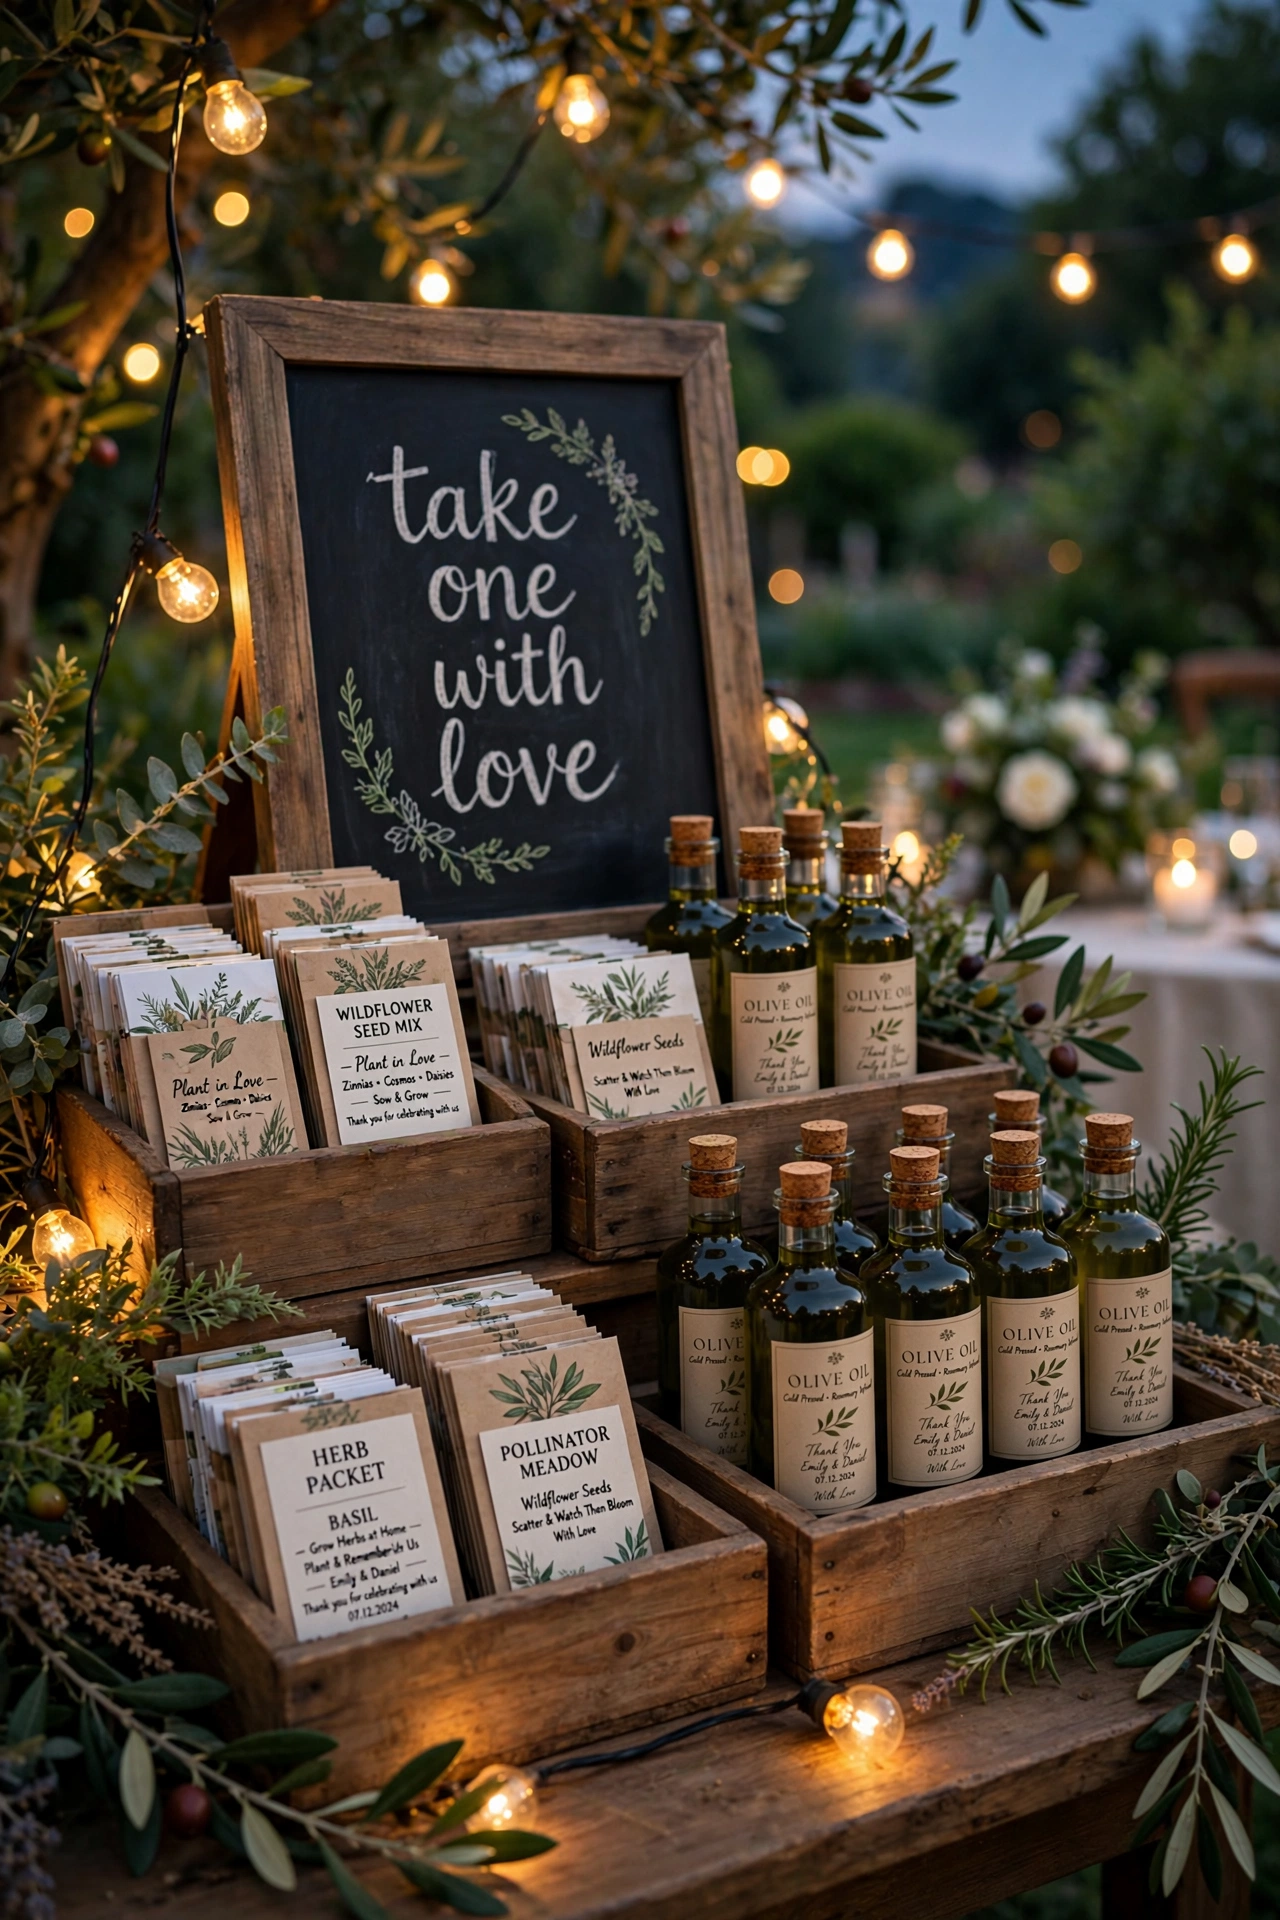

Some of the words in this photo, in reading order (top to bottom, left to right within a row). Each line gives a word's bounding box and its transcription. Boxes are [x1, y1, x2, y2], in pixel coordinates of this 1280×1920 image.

[366, 445, 578, 544] take
[428, 563, 576, 622] one
[434, 625, 603, 709] with
[432, 717, 620, 813] love
[744, 999, 790, 1012] OLIVE
[795, 995, 813, 1008] OIL
[847, 989, 893, 1001] OLIVE
[896, 985, 912, 997] OIL
[336, 998, 432, 1021] WILDFLOWER
[354, 1022, 390, 1039] SEED
[395, 1018, 422, 1034] MIX
[588, 1037, 651, 1059] Wildflower
[654, 1033, 684, 1050] Seeds
[861, 1046, 887, 1057] Thank
[355, 1055, 388, 1072] Plant
[393, 1056, 404, 1067] in
[410, 1049, 436, 1066] Love
[759, 1058, 785, 1069] Thank
[172, 1078, 210, 1099] Plant
[216, 1078, 228, 1090] in
[232, 1070, 264, 1090] Love
[342, 1080, 373, 1091] Zinnias
[384, 1075, 416, 1086] Cosmos
[426, 1070, 454, 1082] Daisies
[594, 1076, 619, 1086] Scatter
[754, 1073, 777, 1083] Emily
[373, 1094, 391, 1105] Sow
[394, 1092, 402, 1103] &
[405, 1090, 429, 1101] Grow
[645, 1084, 659, 1095] Love
[347, 1116, 368, 1126] Thank
[370, 1116, 383, 1126] you
[385, 1111, 394, 1123] for
[397, 1107, 434, 1120] celebrating
[436, 1104, 450, 1115] with
[1099, 1305, 1149, 1321] OLIVE
[1153, 1299, 1170, 1314] OIL
[1003, 1325, 1054, 1341] OLIVE
[1059, 1319, 1077, 1335] OIL
[693, 1336, 744, 1351] OLIVE
[902, 1348, 954, 1364] OLIVE
[959, 1340, 978, 1358] OIL
[788, 1371, 843, 1388] OLIVE
[849, 1363, 869, 1382] OIL
[1115, 1370, 1144, 1383] Thank
[1149, 1365, 1162, 1381] You
[1019, 1392, 1049, 1405] Thank
[1053, 1387, 1069, 1403] You
[1110, 1386, 1135, 1398] Emily
[710, 1402, 739, 1414] Thank
[1014, 1409, 1040, 1421] Emily
[1122, 1414, 1142, 1424] With
[1145, 1411, 1158, 1421] Love
[705, 1418, 730, 1431] Emily
[919, 1417, 949, 1431] Thank
[501, 1425, 610, 1461] POLLINATOR
[805, 1442, 839, 1457] Thank
[914, 1434, 939, 1447] Emily
[944, 1434, 950, 1443] &
[1027, 1437, 1047, 1447] With
[1050, 1435, 1065, 1444] Love
[312, 1440, 369, 1467] HERB
[520, 1448, 598, 1479] MEADOW
[800, 1460, 829, 1473] Emily
[832, 1460, 839, 1469] &
[842, 1448, 867, 1467] Daniel
[926, 1460, 947, 1473] With
[950, 1459, 966, 1471] Love
[306, 1461, 386, 1495] PACKET
[521, 1490, 579, 1511] Wildflower
[582, 1479, 612, 1497] Seeds
[814, 1489, 835, 1501] With
[840, 1485, 856, 1499] Love
[328, 1506, 379, 1530] BASIL
[512, 1519, 543, 1533] Scatter
[546, 1514, 553, 1526] &
[554, 1506, 583, 1523] Watch
[584, 1503, 606, 1516] Then
[607, 1498, 634, 1511] Bloom
[309, 1541, 334, 1555] Grow
[337, 1530, 366, 1548] Herbs
[368, 1530, 378, 1541] at
[380, 1524, 407, 1538] Home
[553, 1527, 575, 1542] With
[576, 1525, 596, 1537] Love
[304, 1557, 330, 1575] Plant
[334, 1557, 341, 1568] &
[407, 1538, 420, 1551] Us
[330, 1572, 356, 1589] Emily
[360, 1570, 368, 1581] &
[371, 1561, 400, 1579] Daniel
[303, 1598, 329, 1616] Thank
[332, 1597, 348, 1612] you
[350, 1591, 362, 1603] for
[364, 1580, 408, 1601] celebrating
[410, 1574, 427, 1589] with
[430, 1574, 438, 1584] us
[348, 1600, 399, 1621] 07.12.2024
